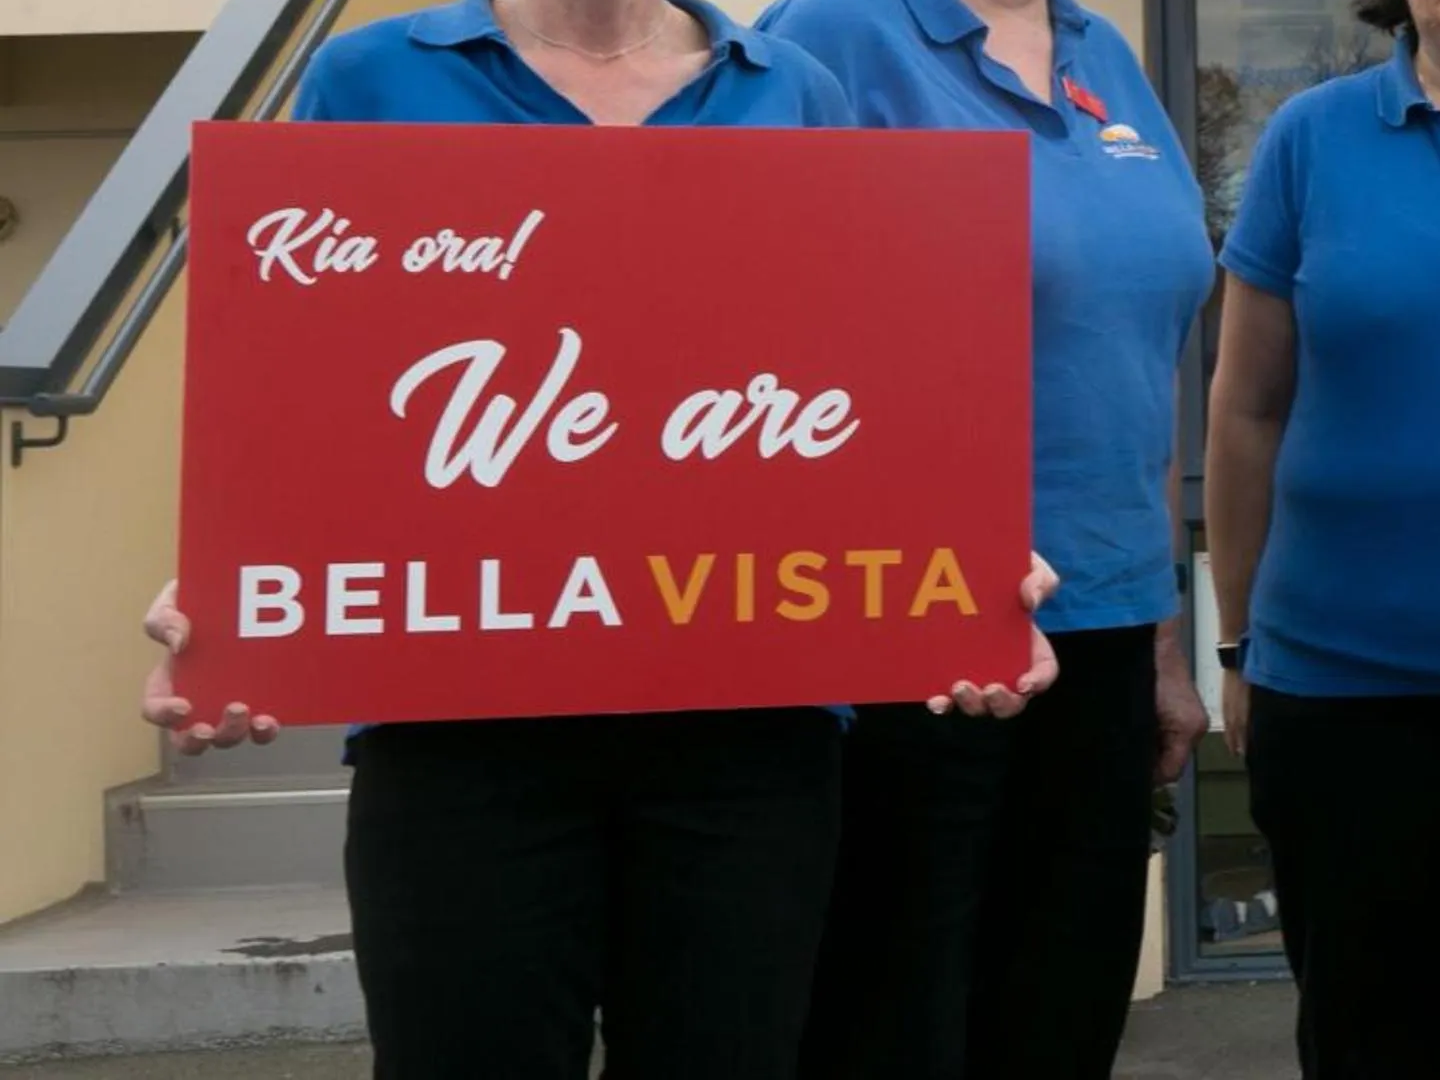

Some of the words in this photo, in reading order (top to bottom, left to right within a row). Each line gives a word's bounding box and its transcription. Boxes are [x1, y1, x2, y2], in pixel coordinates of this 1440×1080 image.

[246, 207, 380, 286] Kia
[401, 208, 546, 281] ora!
[389, 326, 620, 490] We
[660, 372, 861, 462] are
[237, 555, 623, 639] BELLA
[647, 547, 979, 625] VISTA
